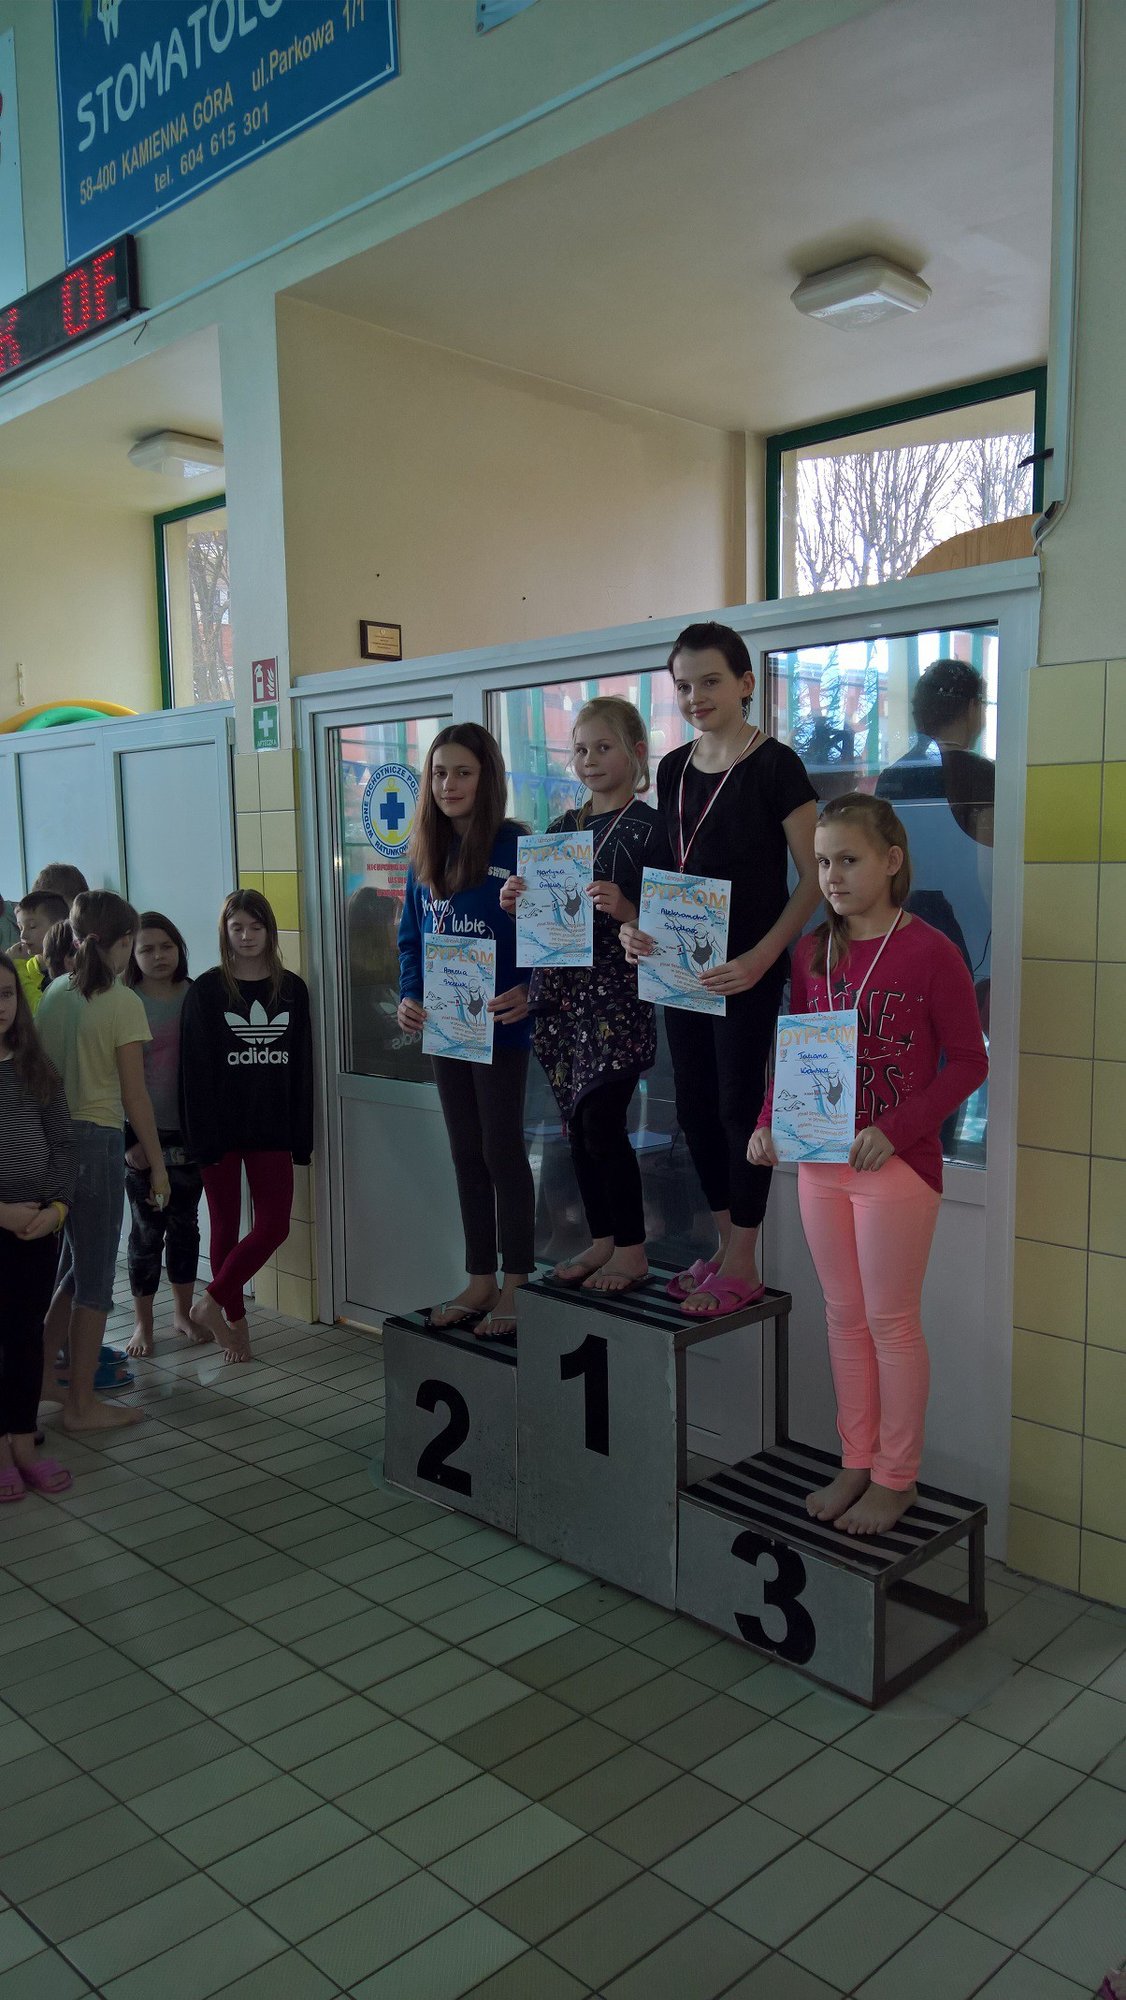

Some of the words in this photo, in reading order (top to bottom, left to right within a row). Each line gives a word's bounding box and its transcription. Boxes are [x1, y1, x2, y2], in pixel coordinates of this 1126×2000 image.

[80, 160, 117, 205] 58-400
[122, 112, 189, 180] KAMIENNA
[193, 81, 234, 131] GÓRA
[154, 166, 174, 193] tel.
[180, 142, 204, 176] 604
[210, 122, 237, 156] 615
[243, 101, 269, 135] 301
[365, 766, 406, 798] OCHOTNICZE
[363, 800, 374, 840] WODNE
[519, 844, 592, 865] DYPLOM
[643, 881, 728, 910] DYPLOM
[425, 943, 494, 965] DYPLOM
[779, 1024, 856, 1048] DYPLOM
[227, 1045, 289, 1066] adidas
[559, 1333, 610, 1457] 1
[415, 1378, 472, 1497] 2
[730, 1530, 817, 1666] 3
